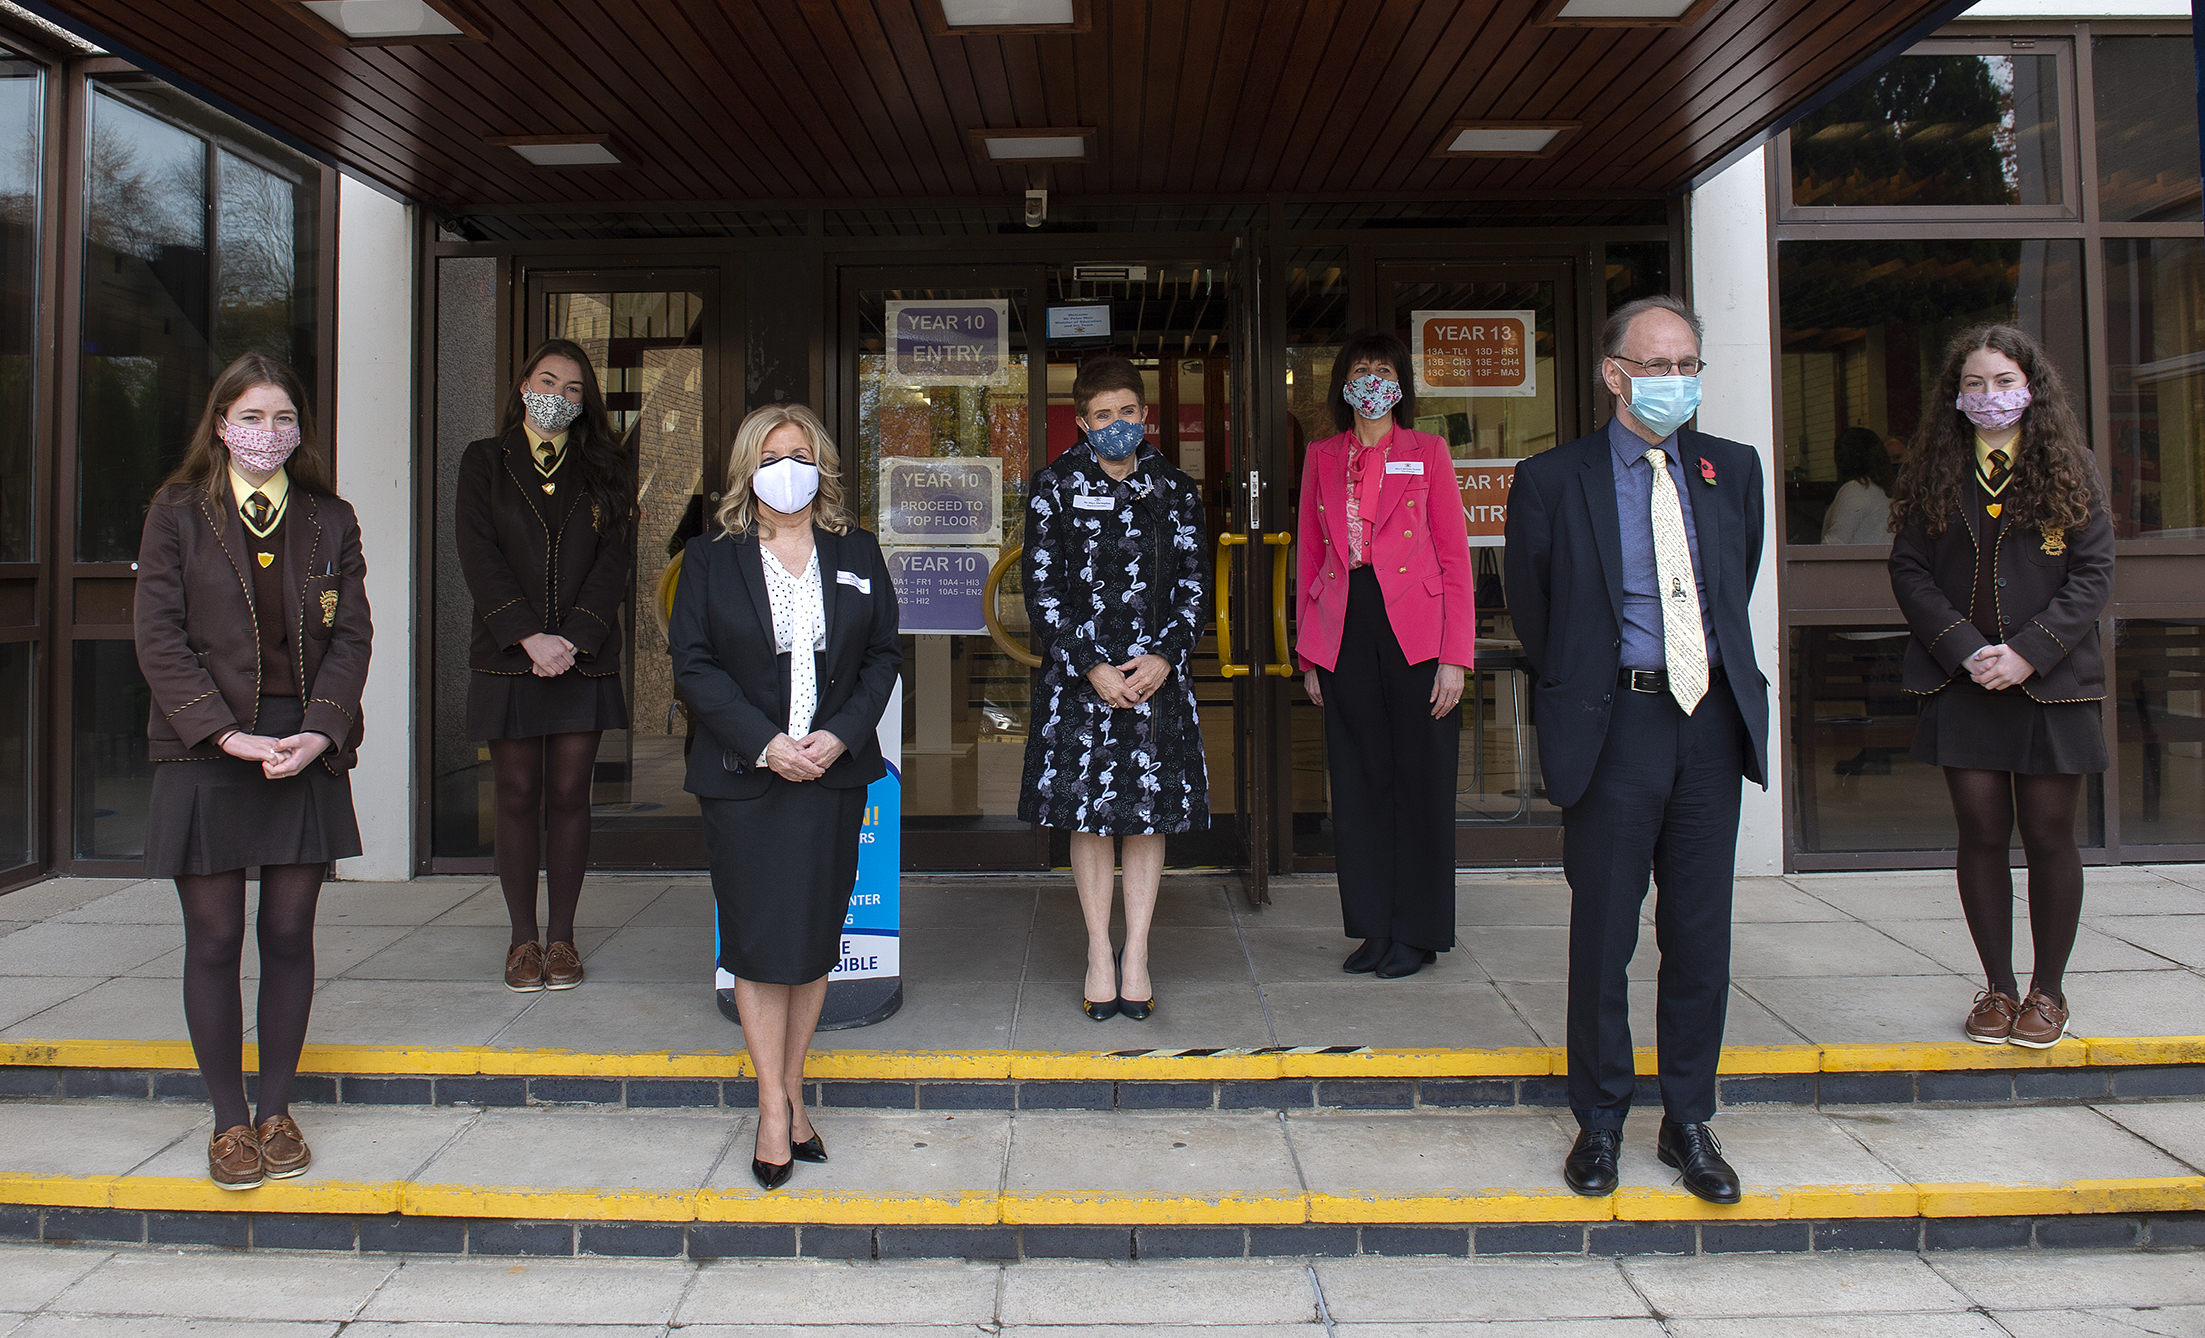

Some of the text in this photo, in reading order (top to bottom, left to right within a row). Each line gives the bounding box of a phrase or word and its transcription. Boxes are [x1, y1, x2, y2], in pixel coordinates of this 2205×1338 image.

[908, 315, 985, 330] YEAR 10
[1434, 325, 1511, 341] YEAR 13
[913, 345, 984, 362] ENTRY
[1427, 348, 1444, 356] 13A
[1452, 348, 1468, 356] TL1
[1476, 348, 1493, 356] 13D
[1501, 348, 1519, 356] HS1
[1427, 358, 1444, 366] 13B
[1452, 358, 1471, 366] CH3
[1476, 358, 1492, 366] 13E
[1500, 358, 1520, 366] CH4
[1427, 369, 1445, 377] 13C
[1453, 369, 1471, 377] SO1
[1476, 369, 1492, 377] 13F
[1501, 369, 1520, 377] MA3
[902, 473, 979, 488] YEAR 10
[1456, 474, 1491, 490] EAR
[901, 500, 983, 511] PROCEED TO
[1462, 505, 1507, 522] NTR
[906, 515, 978, 526] TOP FLOOR
[899, 556, 976, 573] YEAR 10
[916, 578, 931, 586] FR1
[938, 588, 958, 596] 10A5
[966, 588, 983, 596] EN2
[898, 597, 909, 605] A3
[916, 597, 930, 605] HI2
[848, 893, 881, 906] NTER
[828, 956, 878, 973] SIBLE
